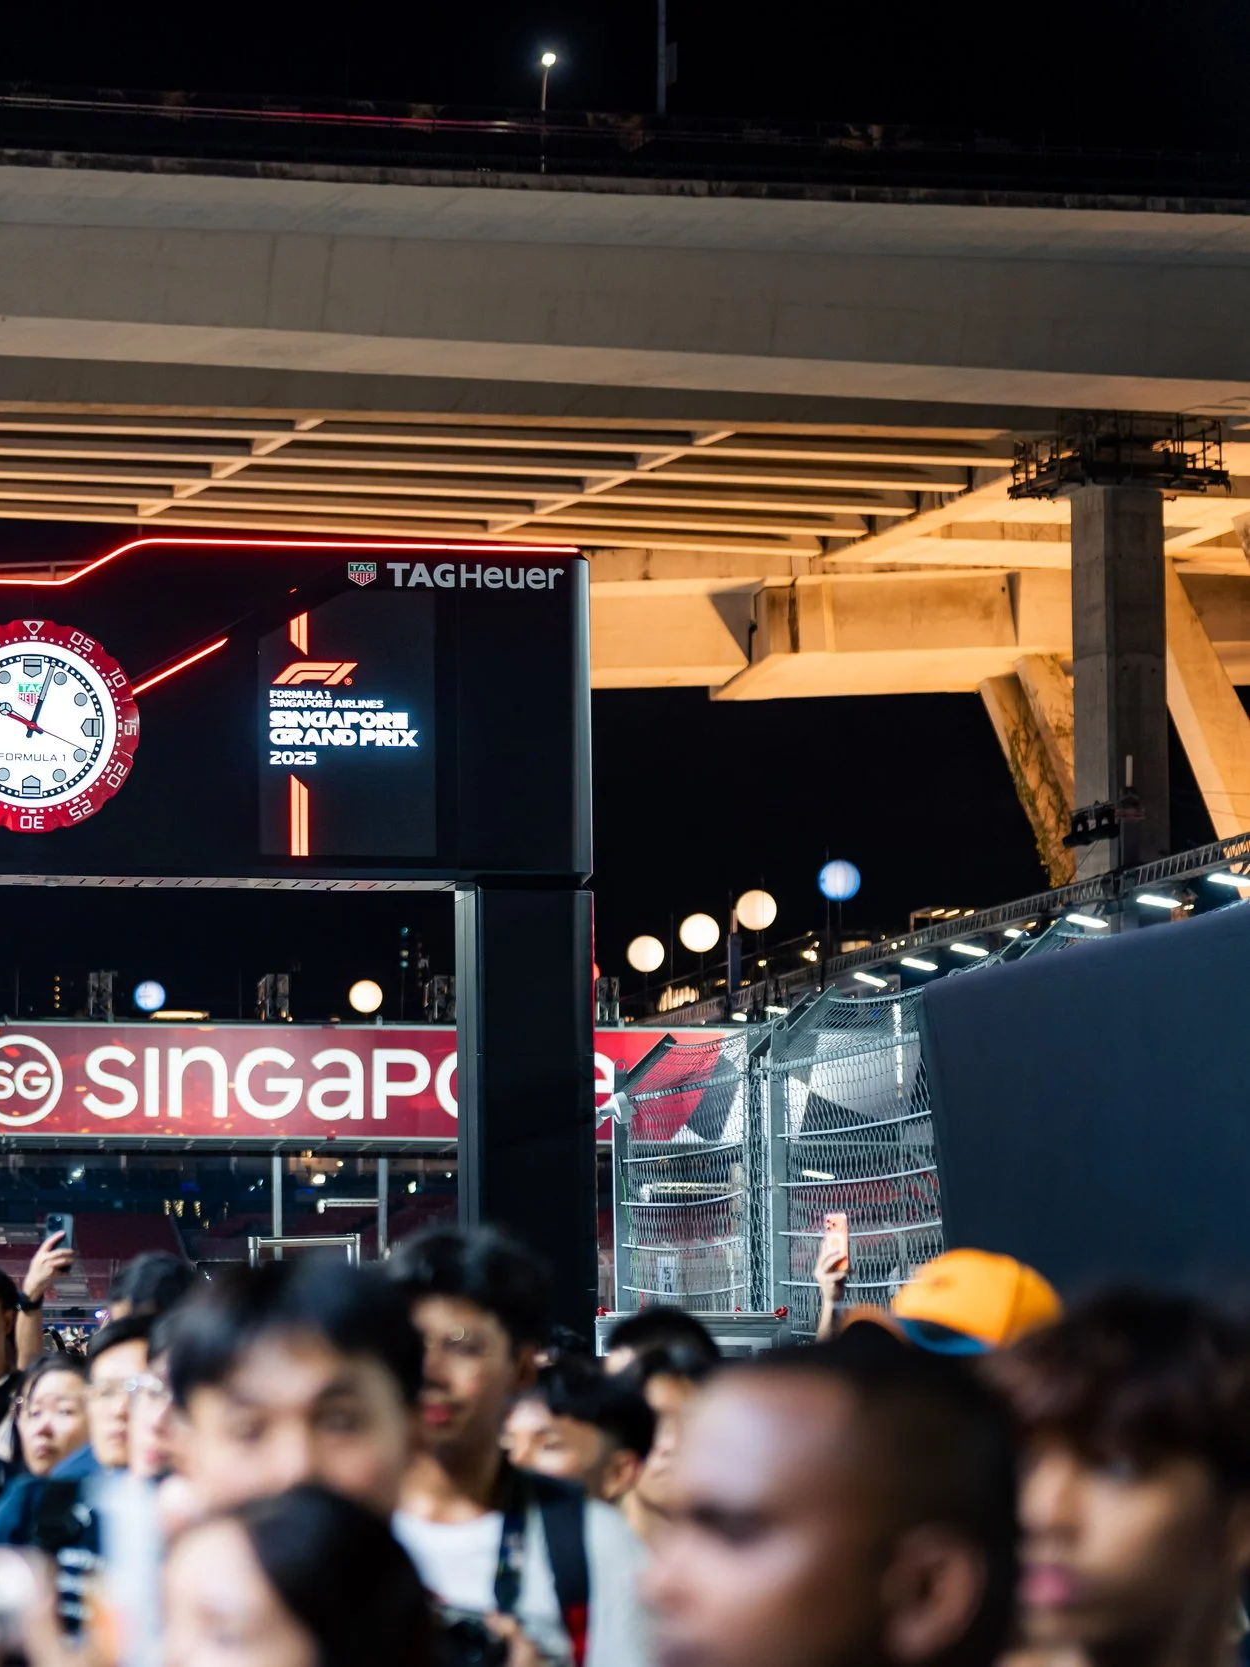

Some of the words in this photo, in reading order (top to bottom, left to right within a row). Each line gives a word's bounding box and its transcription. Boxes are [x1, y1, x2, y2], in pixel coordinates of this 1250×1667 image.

[350, 572, 375, 584] HEUER
[70, 631, 95, 652] 05
[109, 667, 127, 688] 10
[19, 693, 41, 705] HEUE
[269, 690, 323, 699] FORMULA
[323, 690, 331, 699] 1
[269, 699, 333, 708] SINGAPORE
[334, 700, 384, 709] AIRLINES
[124, 718, 137, 736] 15
[269, 711, 409, 729] SINGAPORE
[269, 728, 358, 746] GRAND
[359, 730, 419, 747] PRIX
[269, 751, 317, 765] 2025
[107, 762, 128, 788] 20
[68, 801, 94, 821] 25
[20, 815, 45, 829] 30
